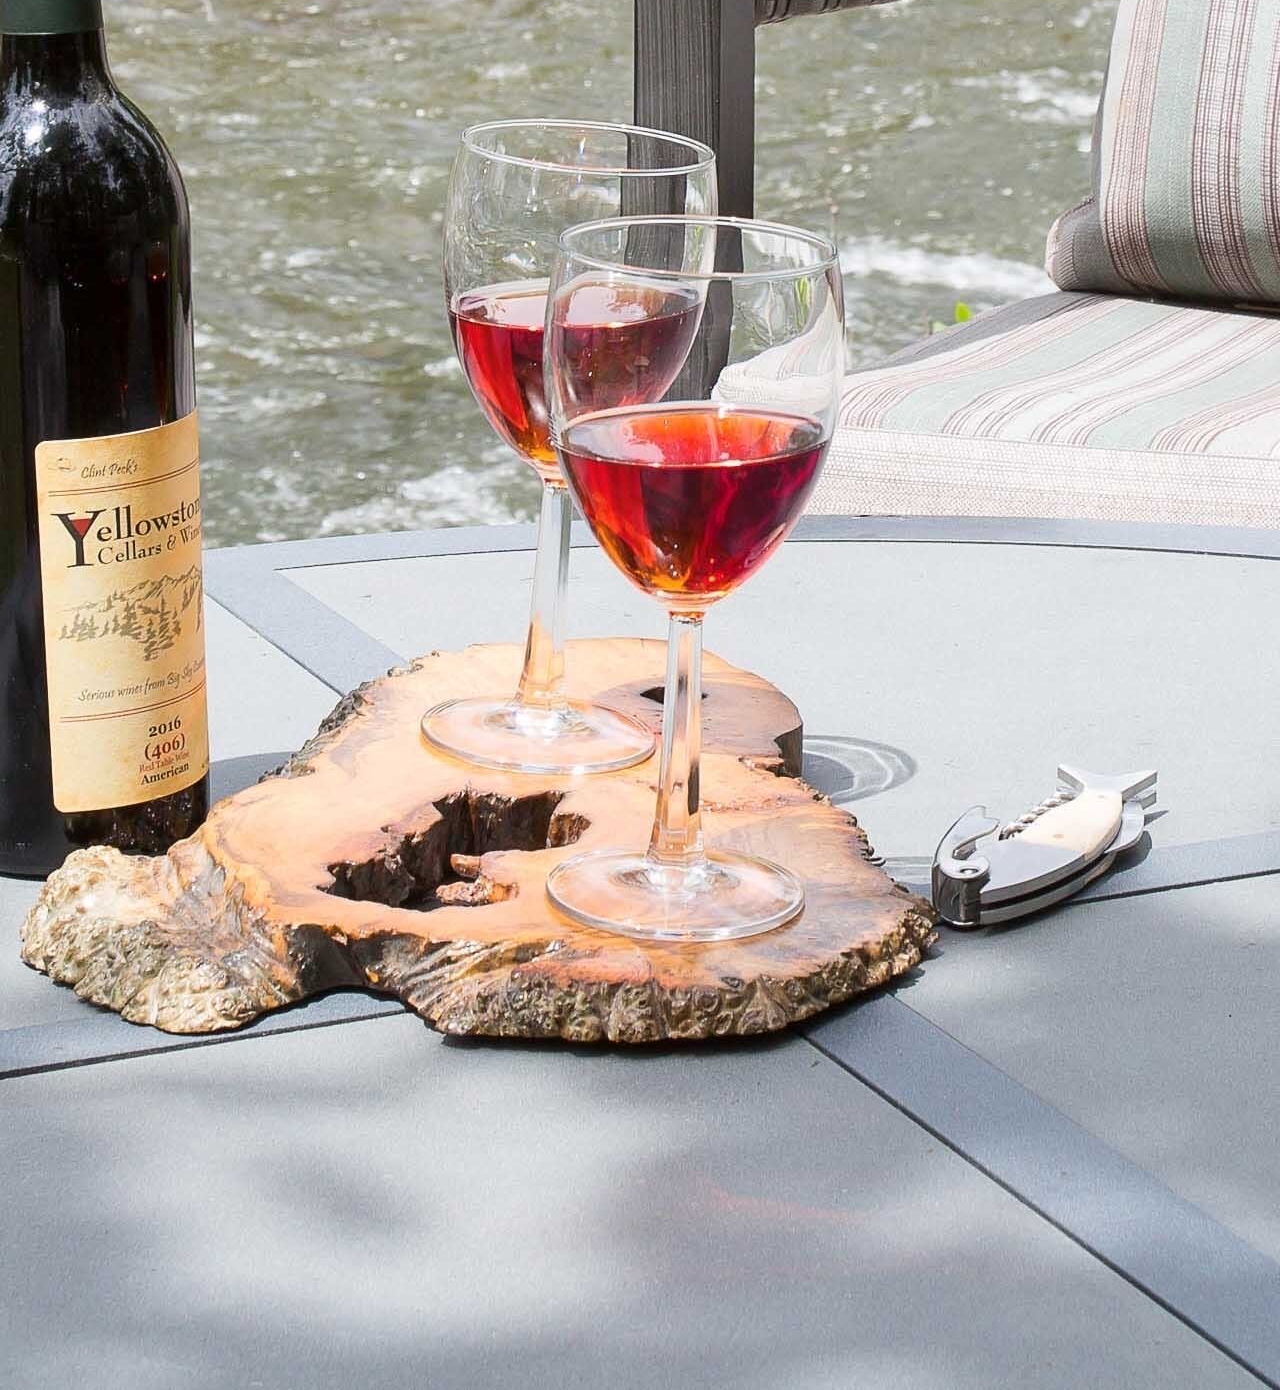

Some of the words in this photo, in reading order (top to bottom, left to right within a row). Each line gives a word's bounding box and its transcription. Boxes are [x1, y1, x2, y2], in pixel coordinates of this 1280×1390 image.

[81, 463, 106, 478] Clint
[109, 458, 138, 476] Peck's
[98, 540, 162, 565] Cellars
[167, 534, 176, 551] &
[78, 690, 115, 702] Serious
[118, 683, 142, 697] wines
[143, 677, 165, 695] from
[166, 671, 180, 689] Big
[149, 714, 181, 737] 2016
[144, 733, 185, 761] (406)
[139, 761, 154, 773] Red
[141, 762, 189, 785] American
